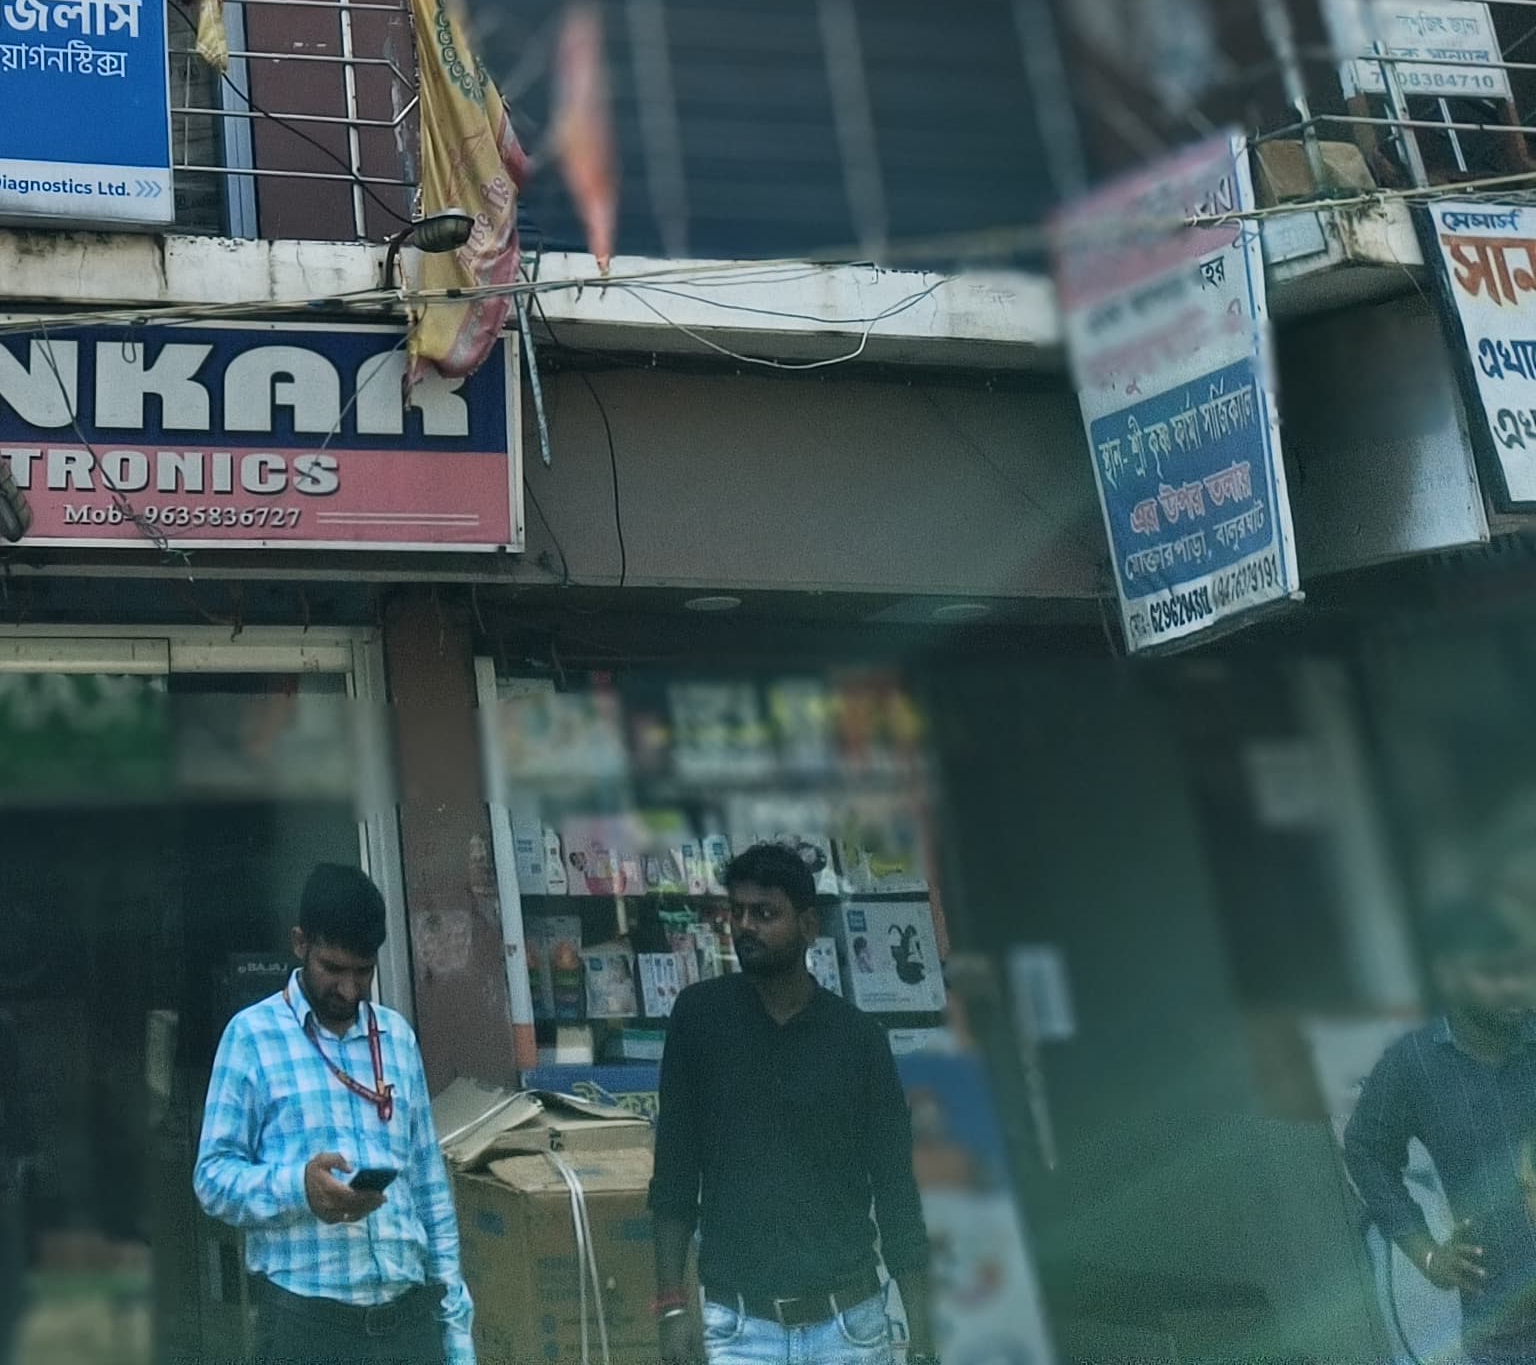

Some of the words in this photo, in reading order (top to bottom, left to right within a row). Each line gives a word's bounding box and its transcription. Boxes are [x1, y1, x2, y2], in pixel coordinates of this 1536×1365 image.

[1370, 71, 1495, 89] 708384710
[98, 180, 131, 197] Ltd.
[144, 504, 302, 527] 9635836727
